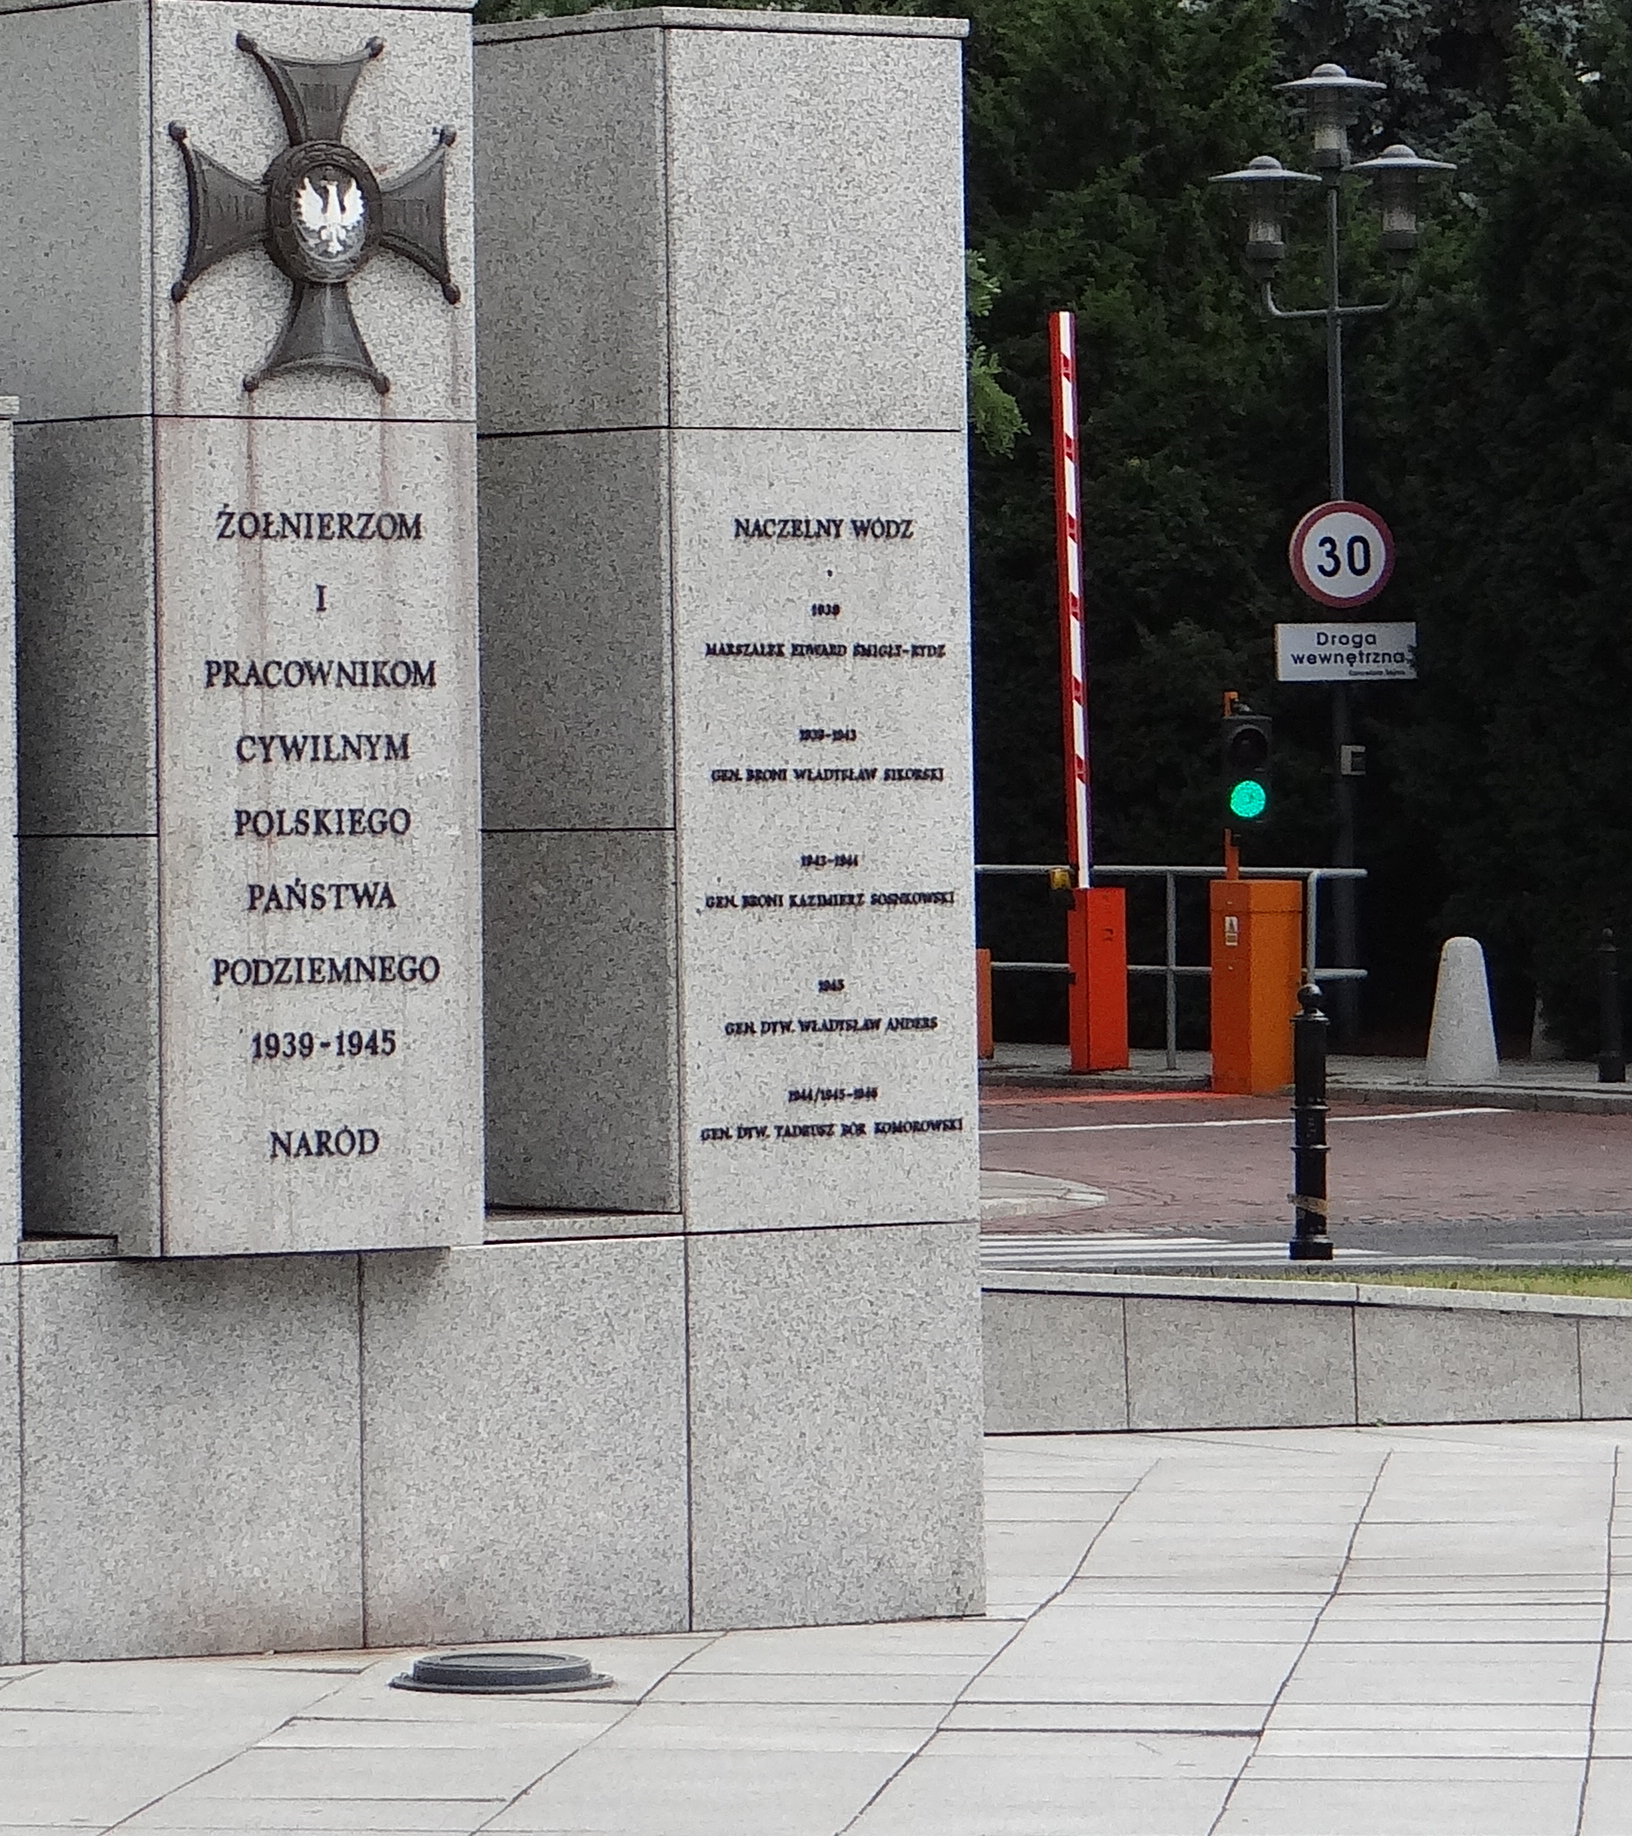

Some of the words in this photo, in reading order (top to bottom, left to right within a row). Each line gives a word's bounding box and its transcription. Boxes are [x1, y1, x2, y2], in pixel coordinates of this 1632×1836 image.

[216, 503, 423, 541] ŻOŁNIERZOM
[734, 517, 844, 539] NACZELNY
[850, 515, 915, 540] WÓDZ
[1317, 535, 1371, 578] 30
[314, 584, 328, 612] I
[1316, 632, 1377, 648] Droga
[204, 659, 437, 689] PRACOWNIKOM
[1290, 650, 1406, 667] wewnętrzna
[236, 732, 411, 763] CYWILNYM
[233, 806, 412, 837] POLSKIEGO
[246, 877, 397, 913] PAŃSTWA
[212, 955, 441, 986] PODZIEMNEGO
[885, 1016, 939, 1032] ANDERS
[269, 1124, 381, 1159] NARÓD
